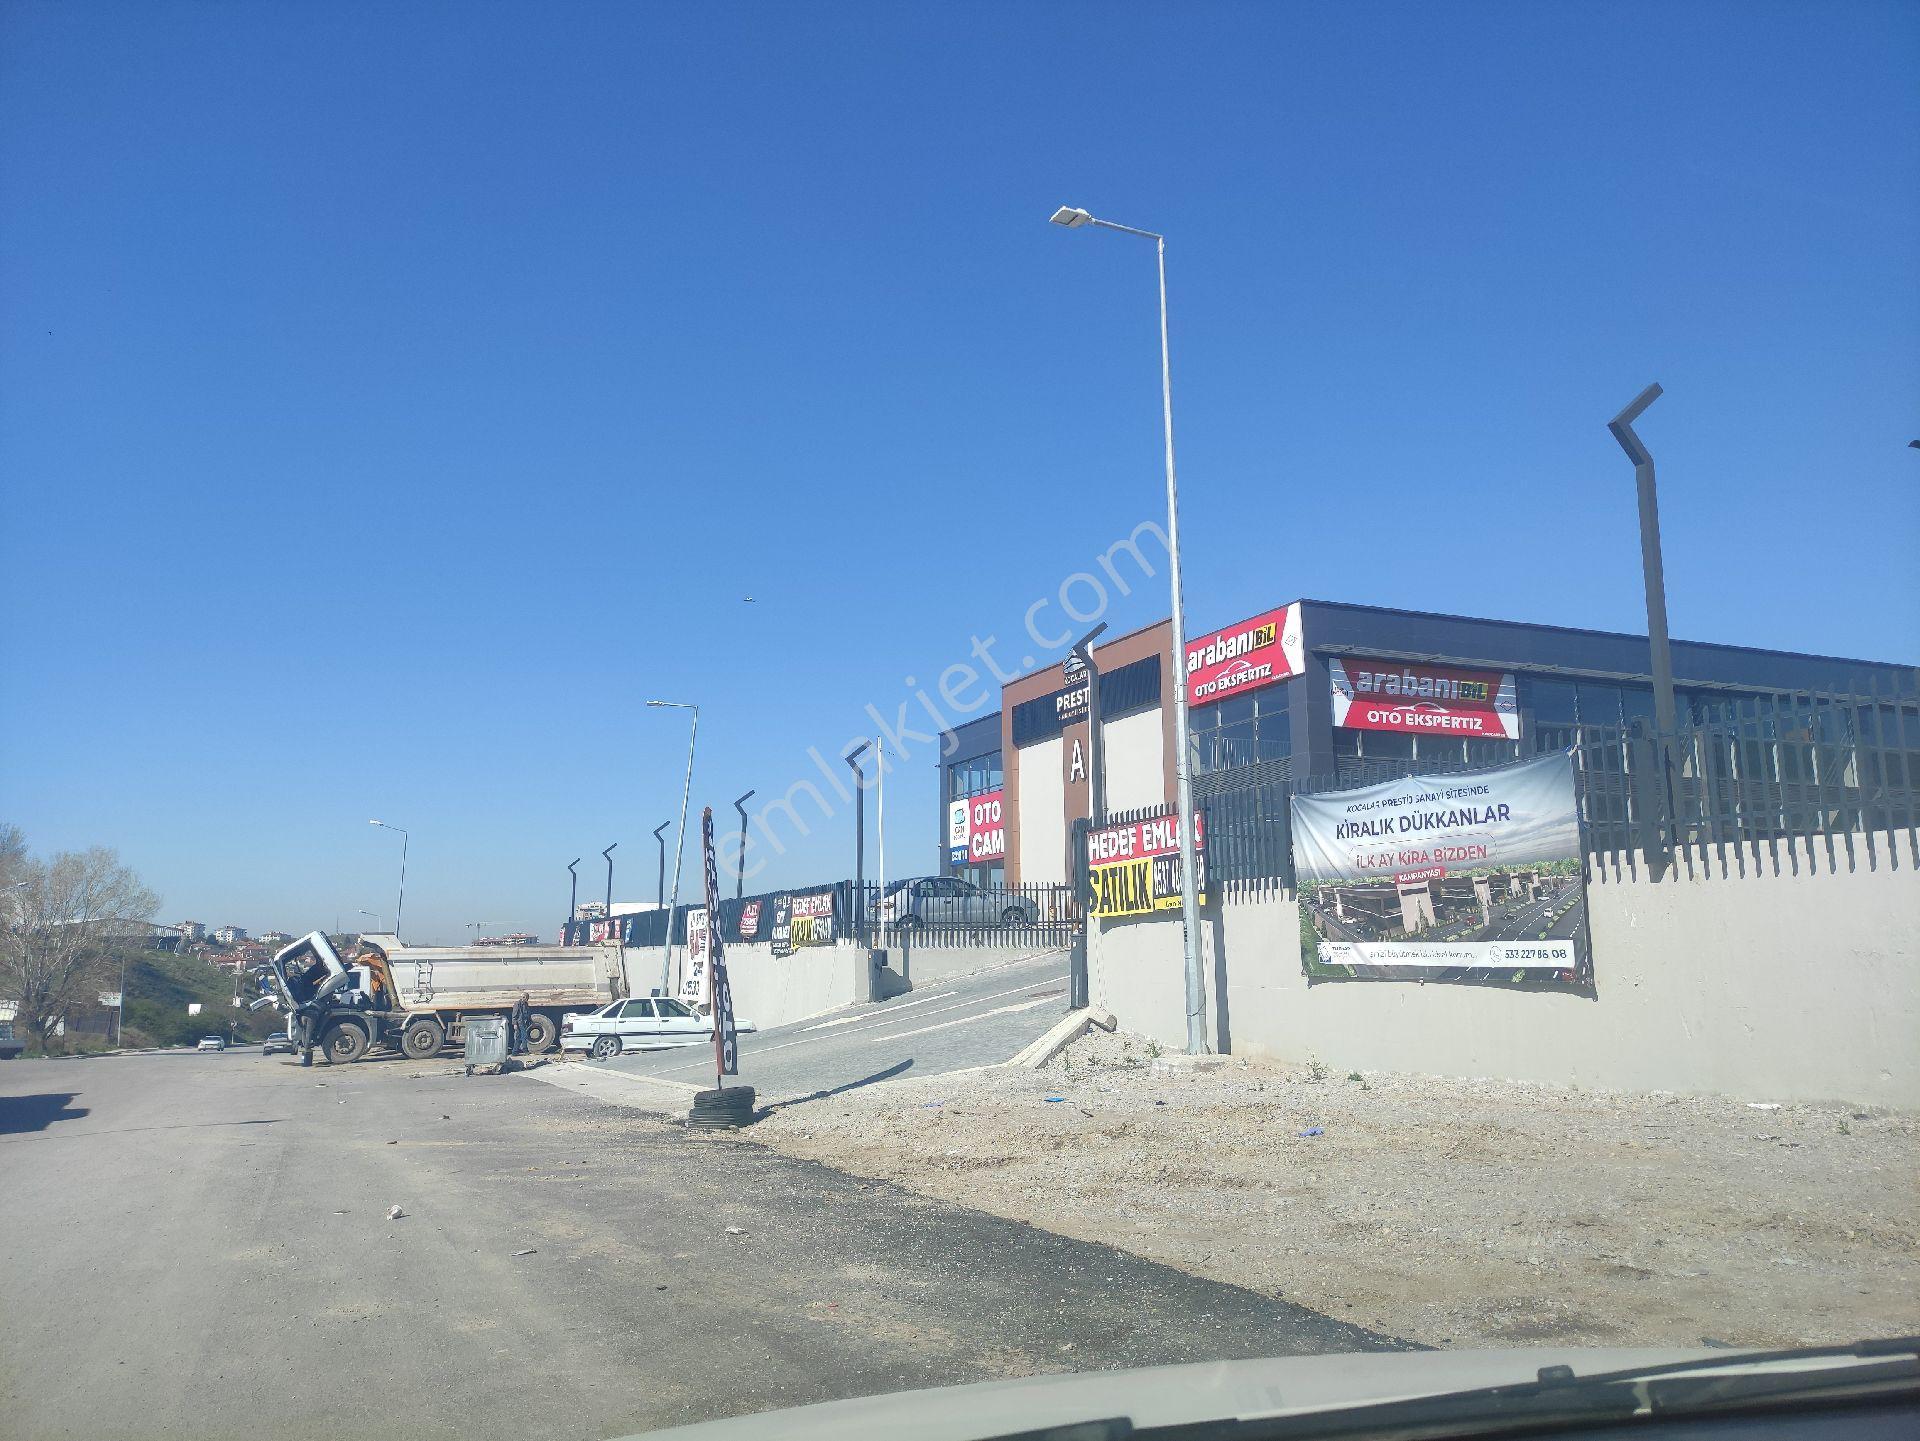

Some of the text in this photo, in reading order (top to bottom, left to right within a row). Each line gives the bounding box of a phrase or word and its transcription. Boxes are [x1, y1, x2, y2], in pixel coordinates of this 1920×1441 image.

[1195, 681, 1217, 697] OTO
[1367, 710, 1402, 725] OTO
[1070, 738, 1086, 783] A
[1445, 784, 1490, 800] SİTESİNDE
[974, 799, 1002, 826] OTO
[1336, 803, 1511, 840] KİRALIK DÜKKANLAR
[972, 828, 1005, 858] CAM
[1088, 826, 1137, 861] HEDEF
[1356, 844, 1487, 869] İLK AY KİRA BİZDEN
[1088, 861, 1152, 914] SATILIK
[1398, 868, 1441, 883] KAMPANYASI
[1551, 949, 1567, 959] 08
